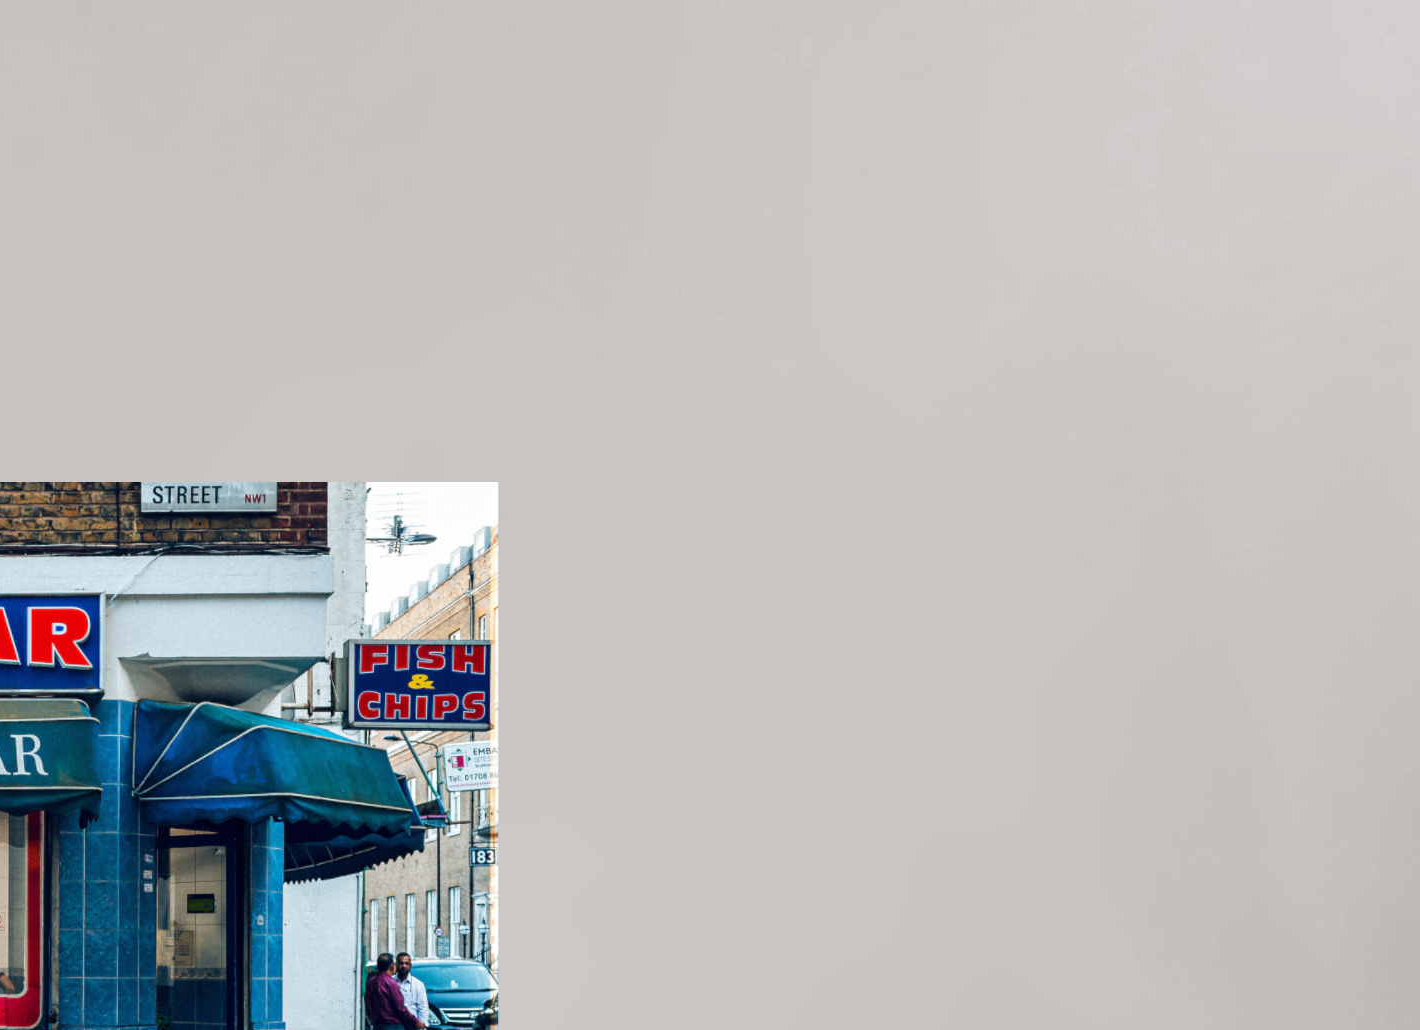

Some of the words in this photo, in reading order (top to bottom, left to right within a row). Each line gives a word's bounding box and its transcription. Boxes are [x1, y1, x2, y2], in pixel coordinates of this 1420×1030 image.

[152, 485, 223, 504] STREET
[244, 493, 266, 504] NW1
[359, 644, 487, 675] FISH
[407, 673, 436, 690] &
[357, 690, 487, 721] CHIPS
[448, 775, 463, 783] Tel:
[464, 773, 488, 781] 01708
[471, 850, 495, 864] 183
